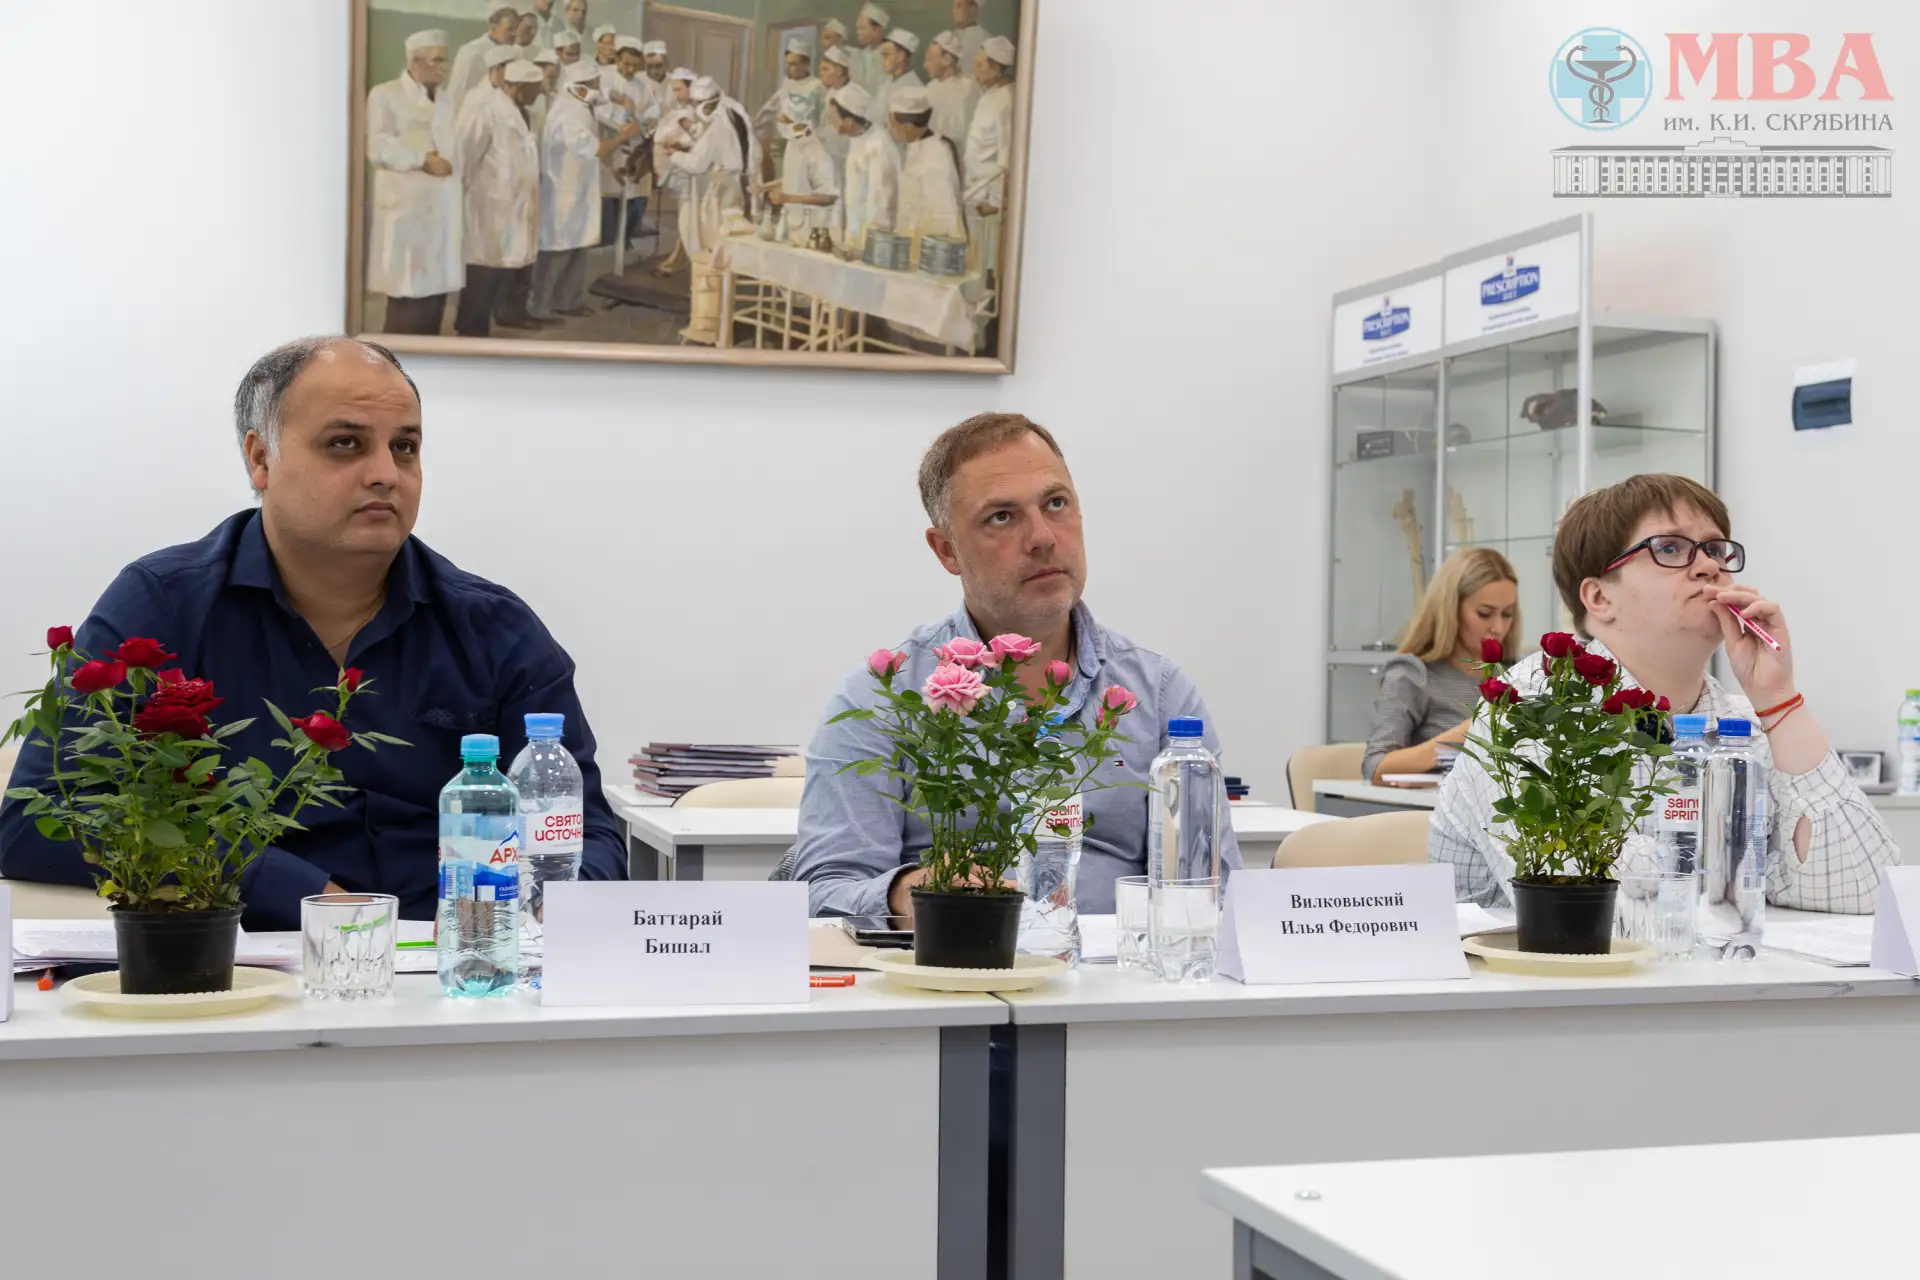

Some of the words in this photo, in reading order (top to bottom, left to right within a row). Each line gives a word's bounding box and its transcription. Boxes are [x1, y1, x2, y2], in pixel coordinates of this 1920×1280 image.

[1291, 892, 1404, 909] Вилковыский
[633, 910, 723, 929] Баттарай
[1281, 920, 1325, 935] Илья
[1329, 919, 1419, 936] Федорович
[645, 938, 711, 954] Бишал
